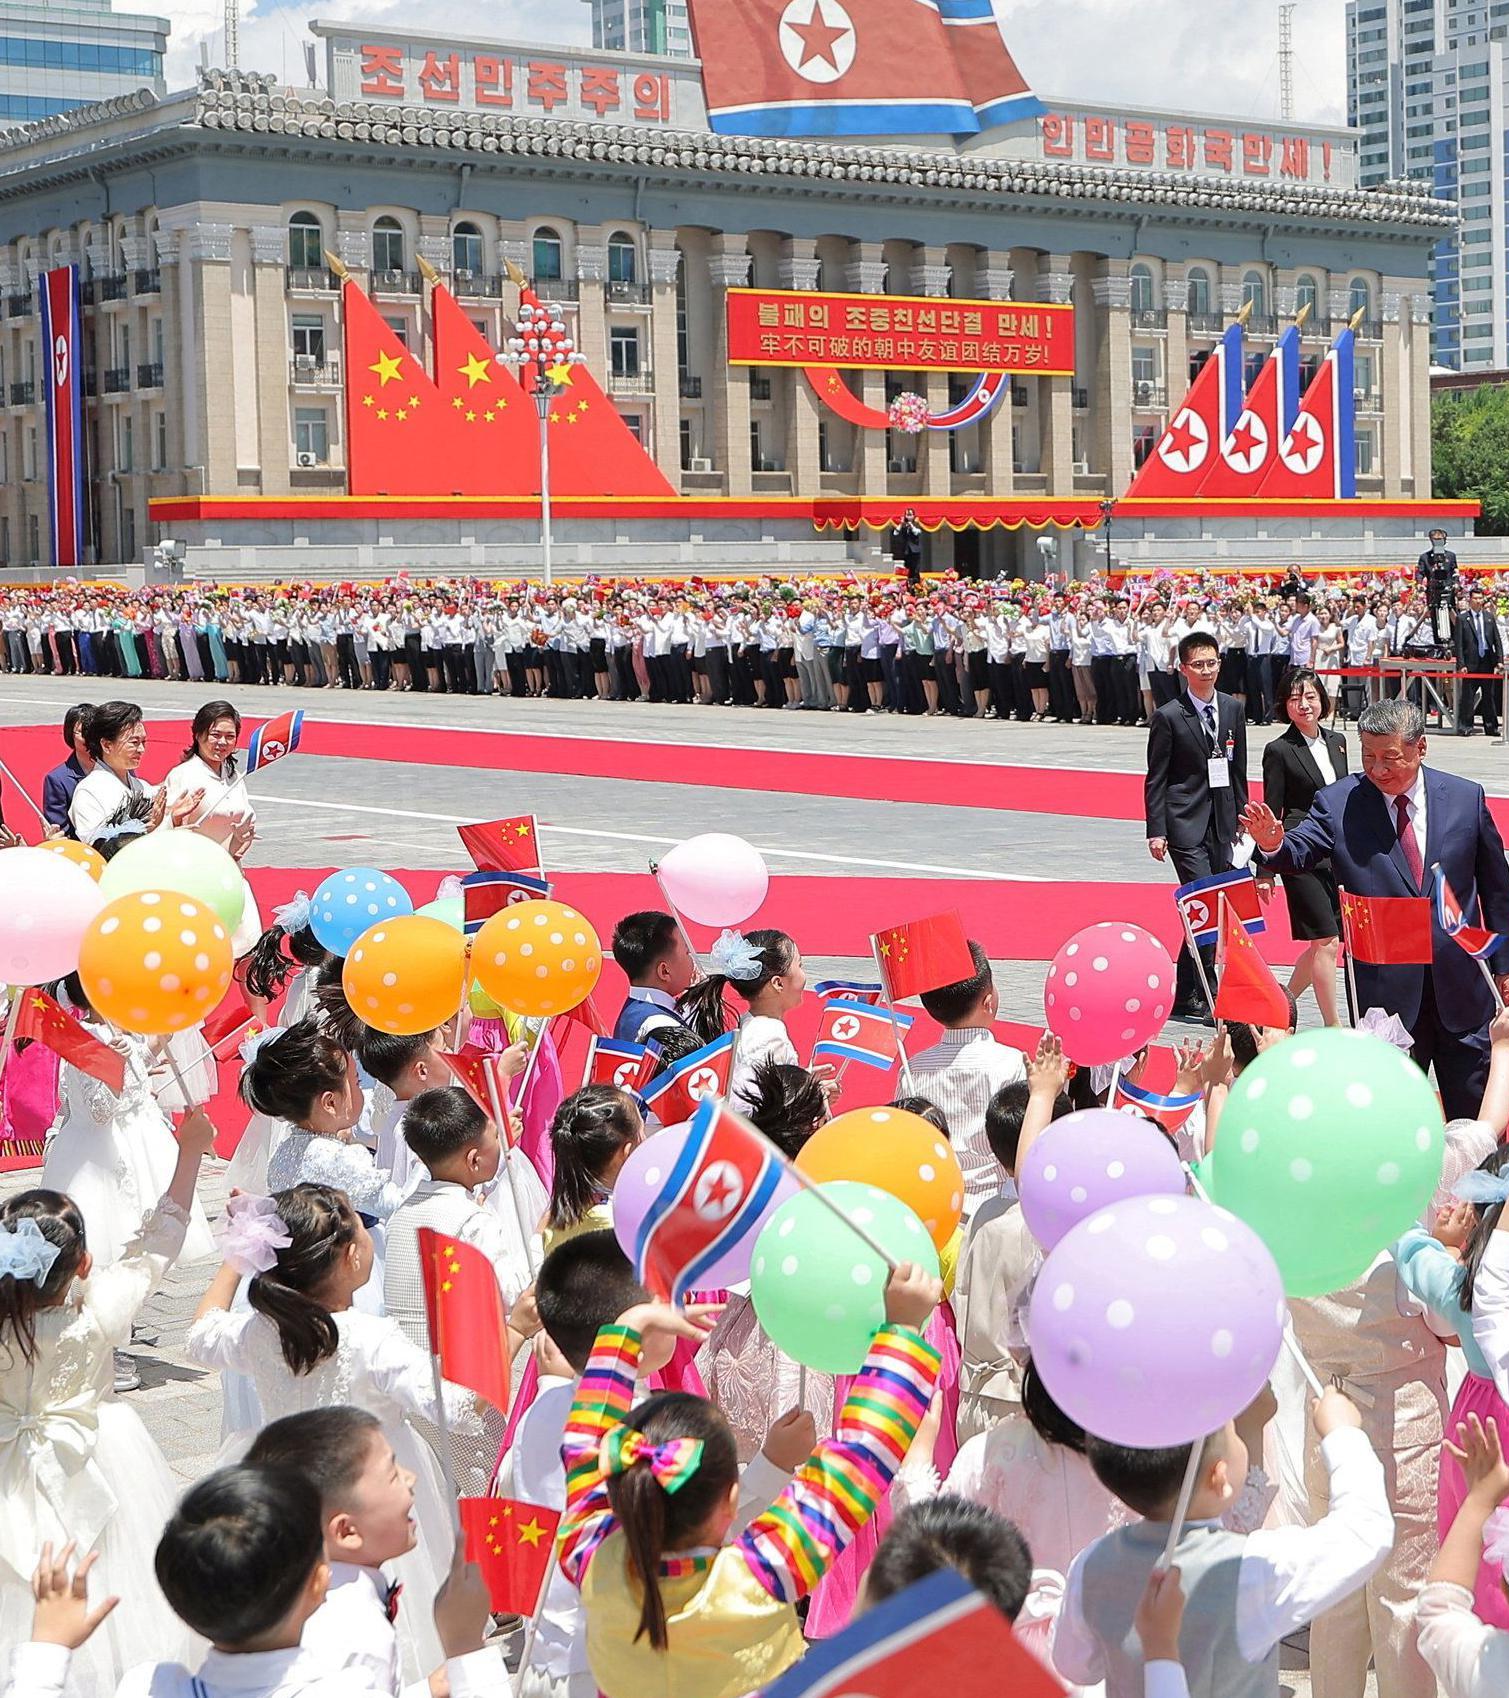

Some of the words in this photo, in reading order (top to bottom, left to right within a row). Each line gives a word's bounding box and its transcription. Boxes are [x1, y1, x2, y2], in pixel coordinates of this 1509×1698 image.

[360, 45, 669, 120] 조선민주주의
[758, 303, 829, 330] 불패의
[845, 306, 982, 335] 조중친선단결
[998, 313, 1053, 339] 만세!
[760, 332, 1049, 365] 牢不可破的朝中友谊团结万岁!
